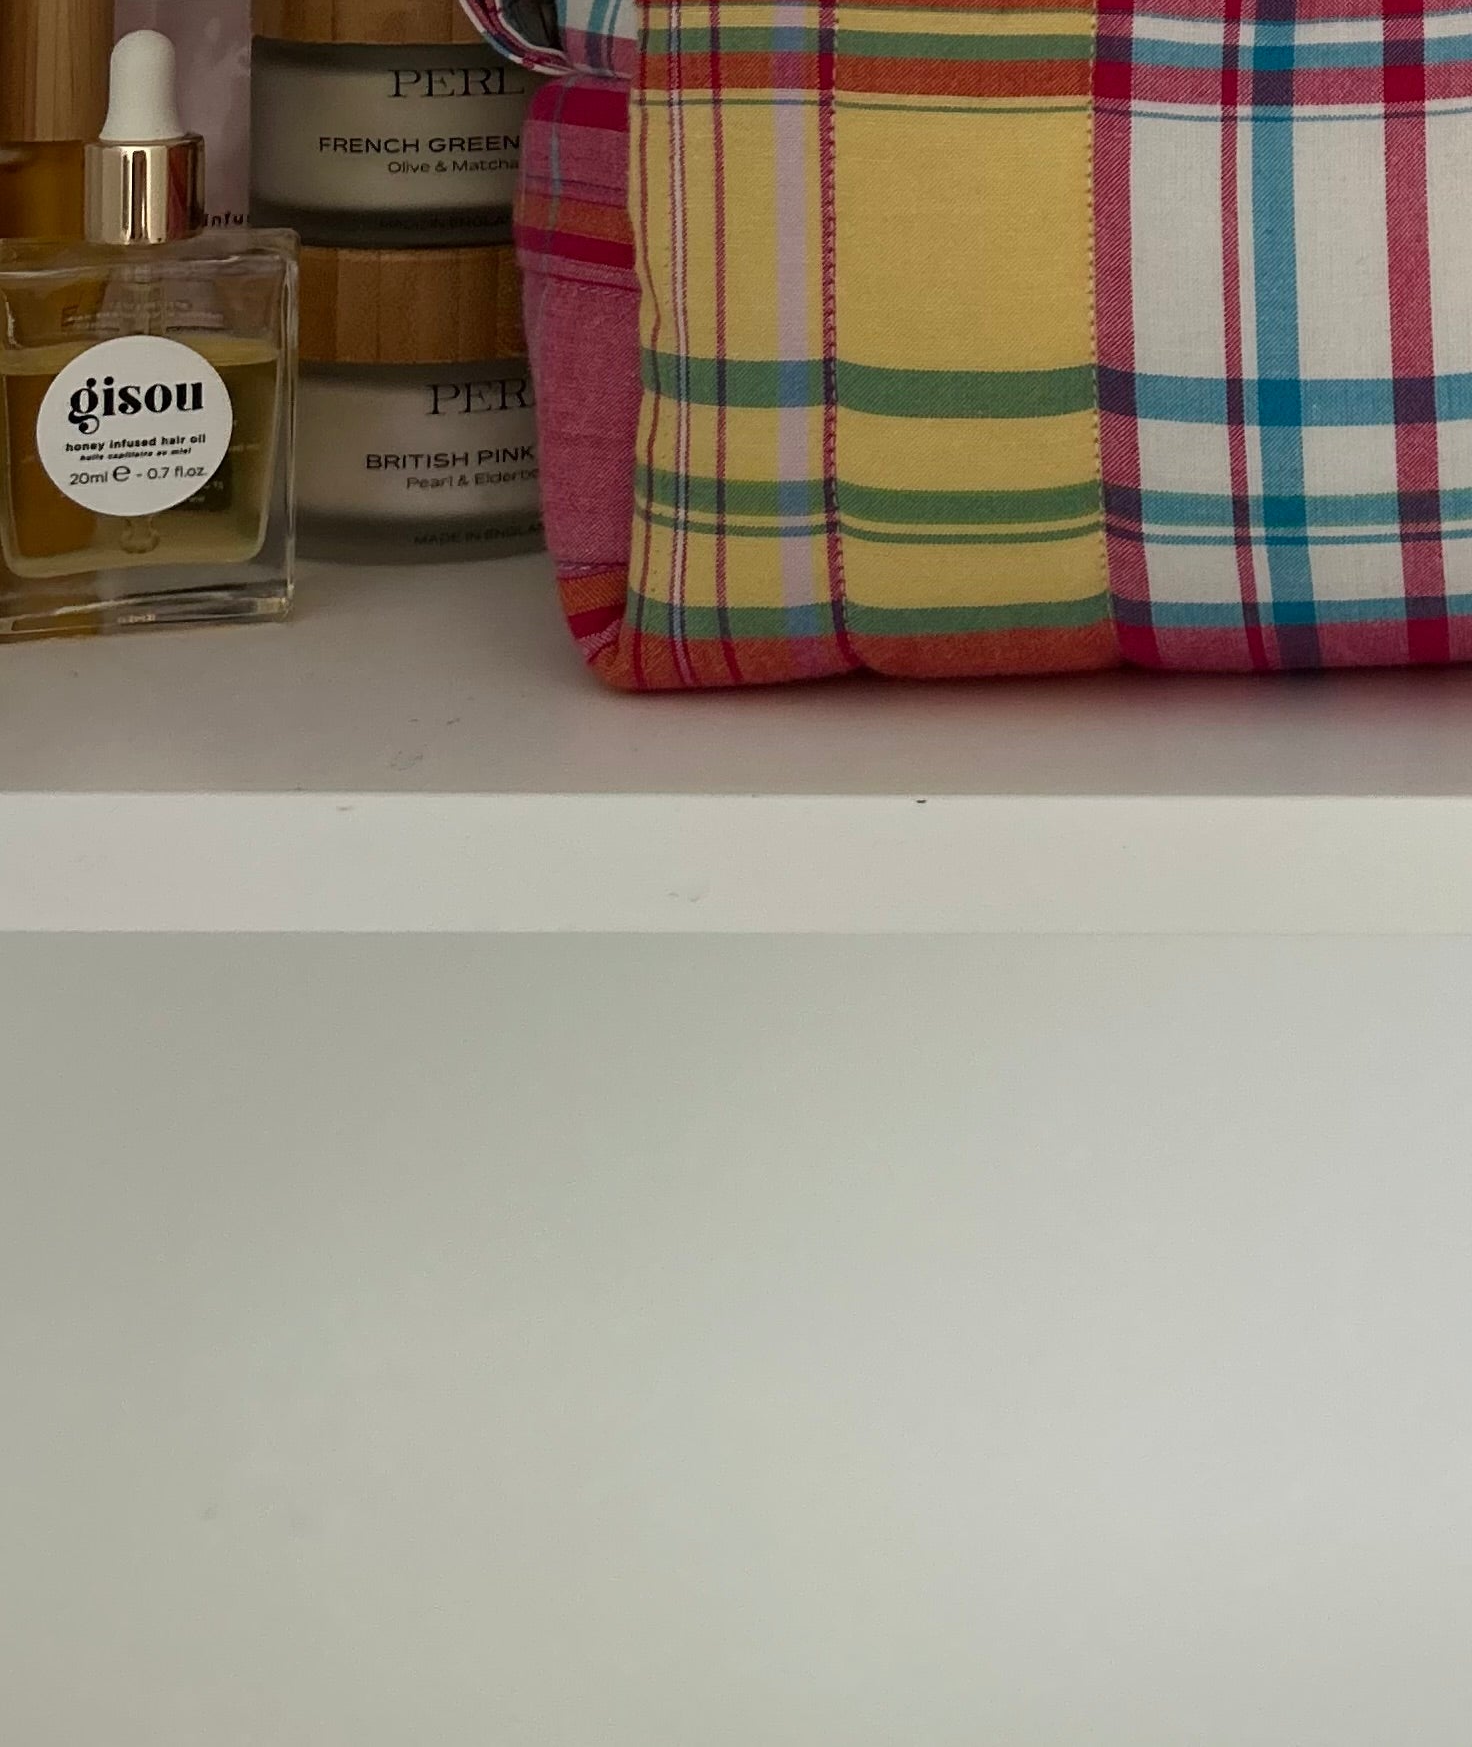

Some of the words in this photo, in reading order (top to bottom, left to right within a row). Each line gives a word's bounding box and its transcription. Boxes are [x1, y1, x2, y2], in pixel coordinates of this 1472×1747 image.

[388, 66, 525, 98] PERL
[319, 137, 419, 153] FRENCH
[428, 135, 520, 153] GREEN
[388, 160, 430, 174] Olive
[435, 160, 447, 173] &
[68, 376, 204, 435] gisou
[65, 440, 104, 453] honey
[109, 436, 156, 450] infused
[161, 434, 185, 446] hair
[190, 433, 206, 444] oil
[366, 452, 469, 470] BRITISH
[478, 446, 534, 465] PINK
[70, 471, 108, 485] 20ml
[147, 467, 169, 479] 0.7
[406, 475, 454, 490] Pearl
[457, 475, 469, 487] &
